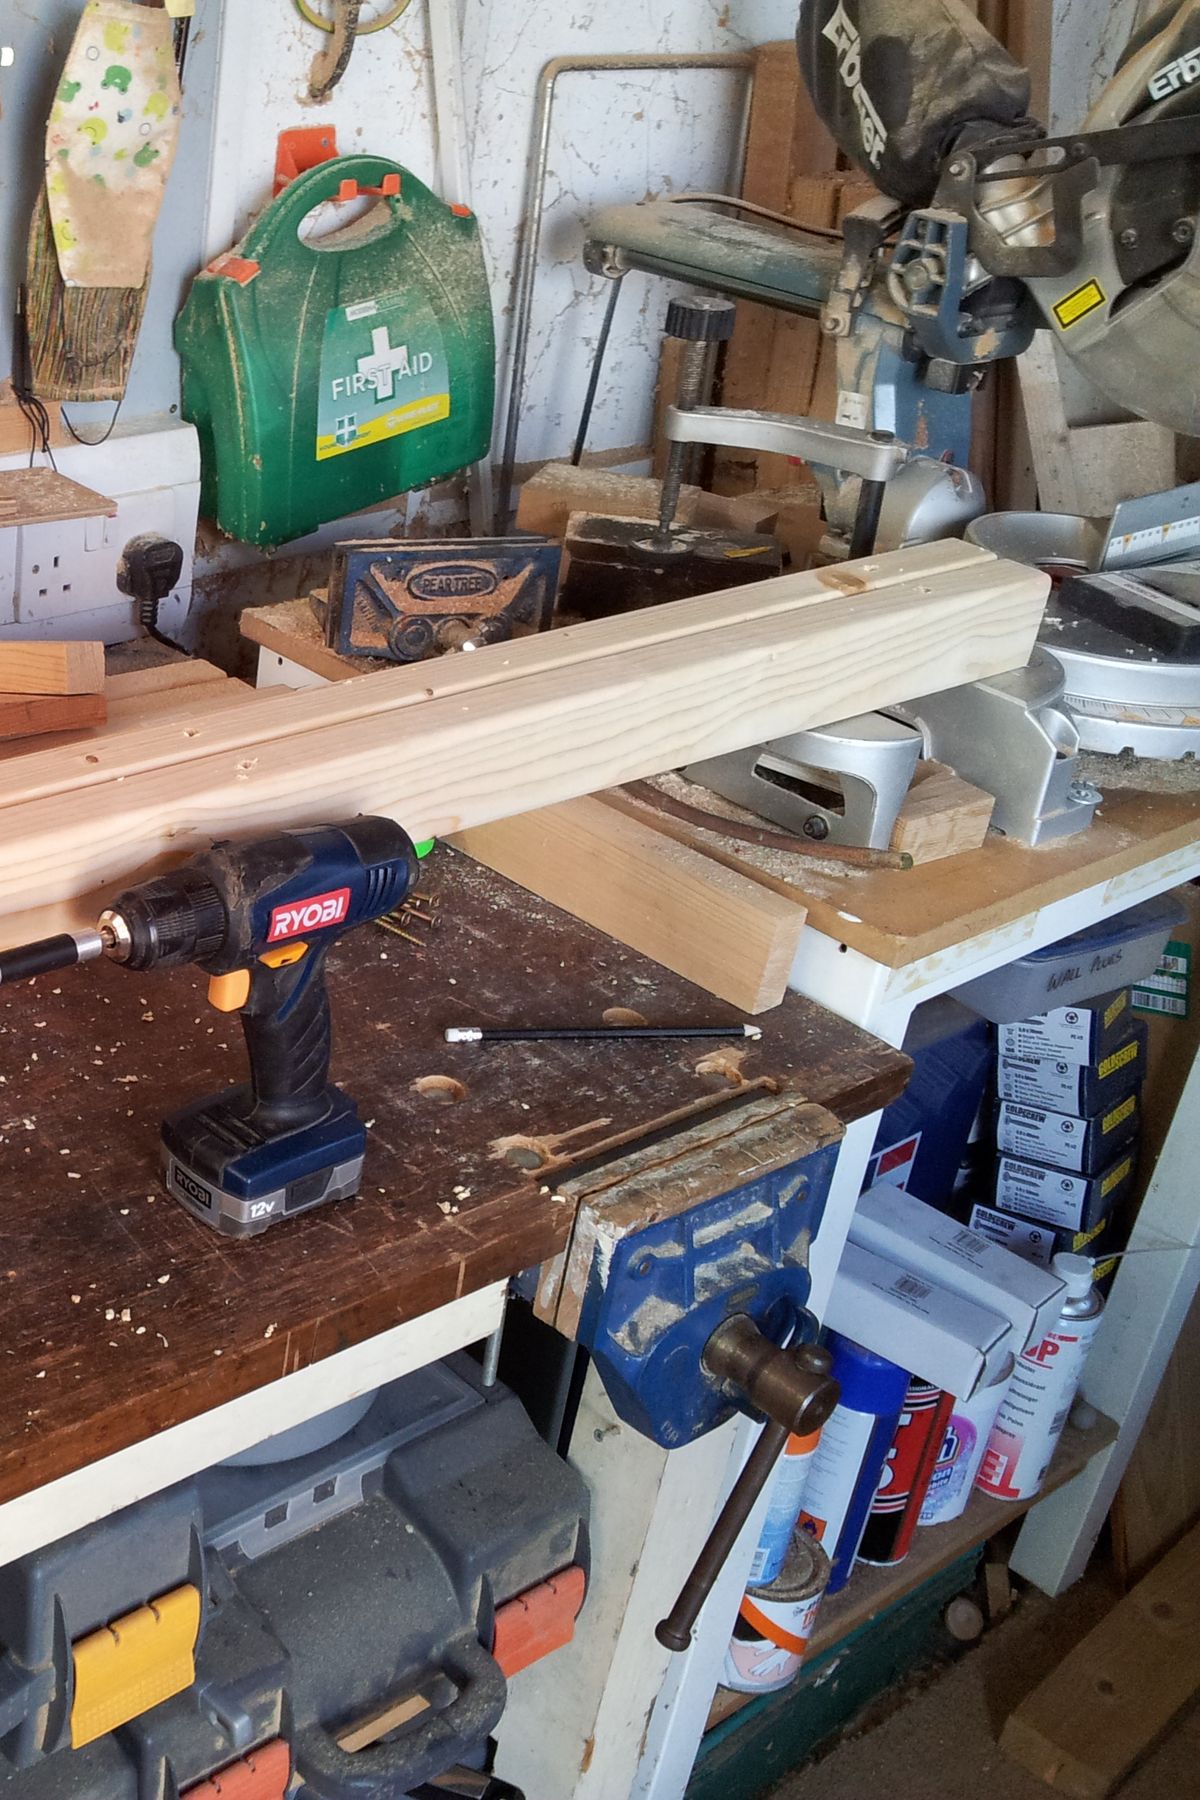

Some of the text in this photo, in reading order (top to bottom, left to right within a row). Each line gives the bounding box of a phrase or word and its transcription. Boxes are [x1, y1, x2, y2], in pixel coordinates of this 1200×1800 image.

[331, 352, 433, 401] FIRST AID
[273, 896, 345, 937] RYOBI
[1046, 967, 1083, 993] WALL
[1005, 1103, 1047, 1123] GOLDSCREW
[1003, 1160, 1047, 1182] GOLDSCREW
[175, 1168, 211, 1206] RYOBI
[975, 1207, 1016, 1232] GOLDSCREW
